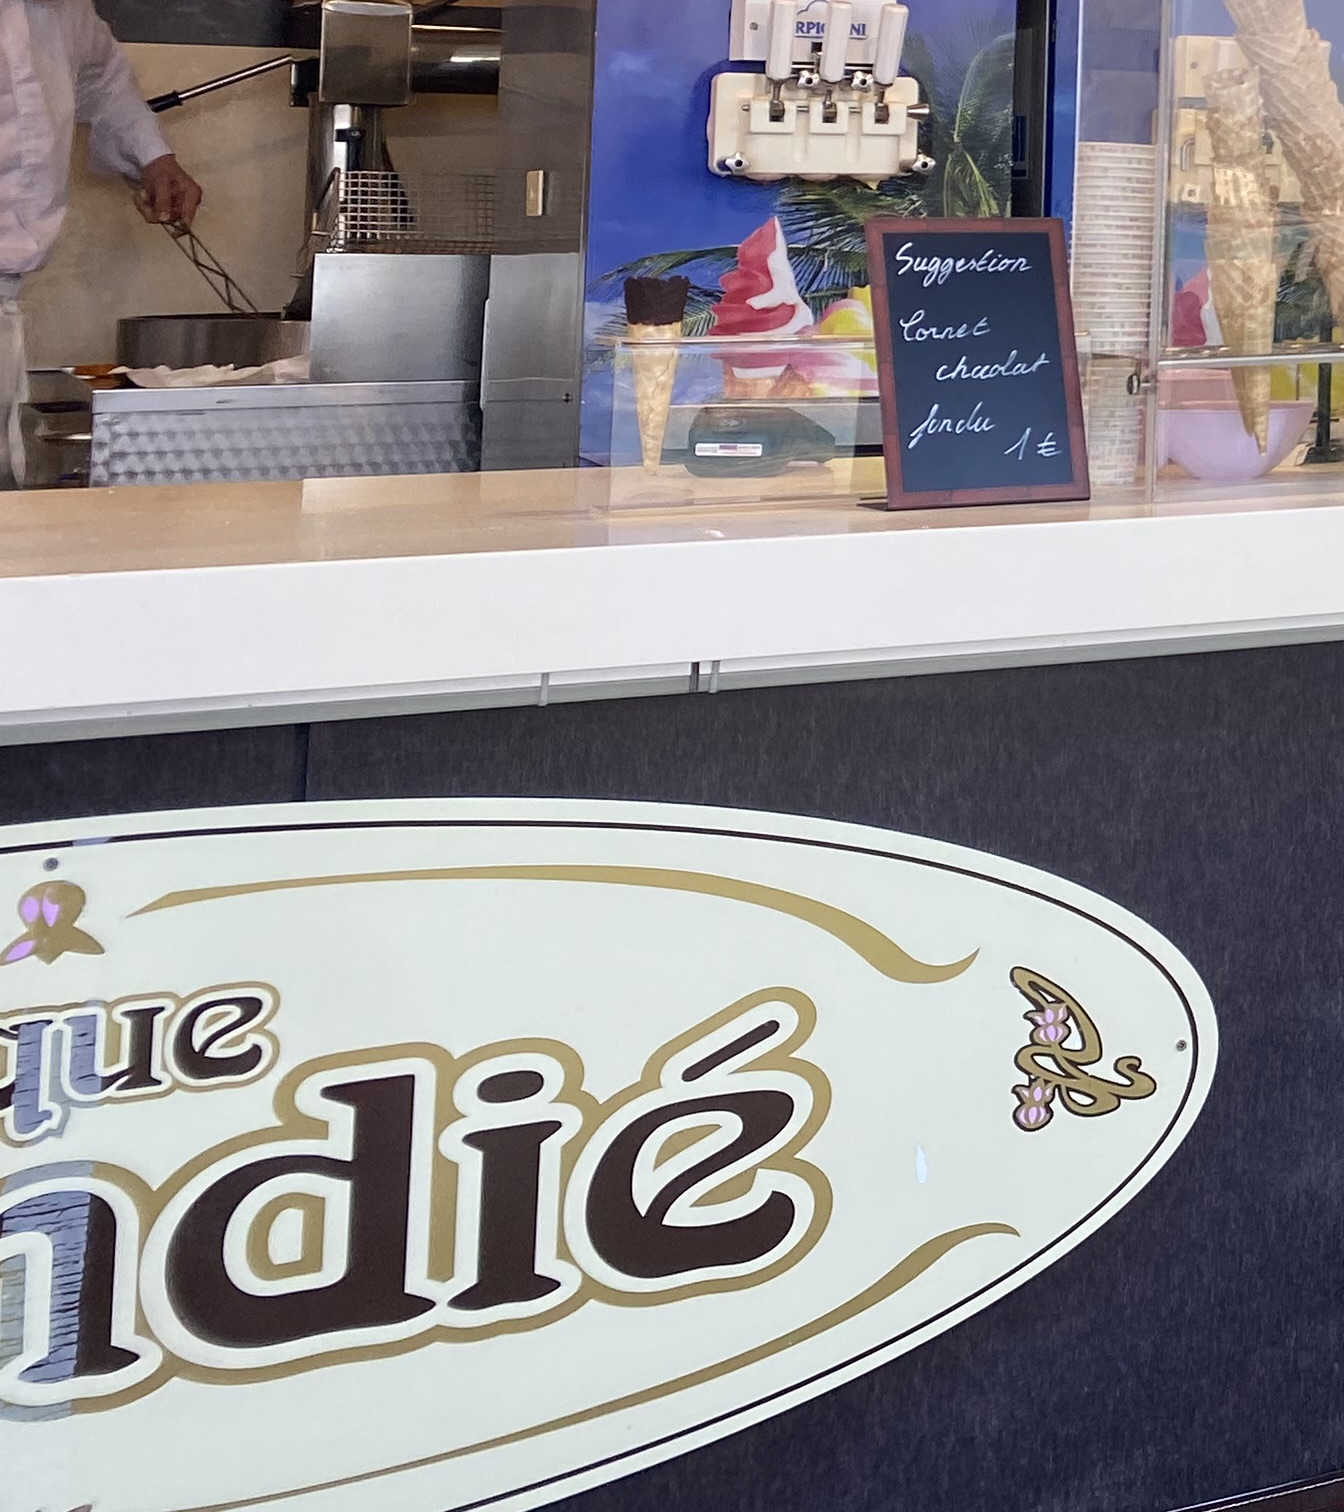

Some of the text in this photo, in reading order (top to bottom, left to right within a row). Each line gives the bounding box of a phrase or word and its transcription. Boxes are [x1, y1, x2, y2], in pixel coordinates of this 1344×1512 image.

[895, 242, 1032, 287] Suggestion
[900, 309, 991, 342] Cornet
[908, 401, 995, 449] fondu
